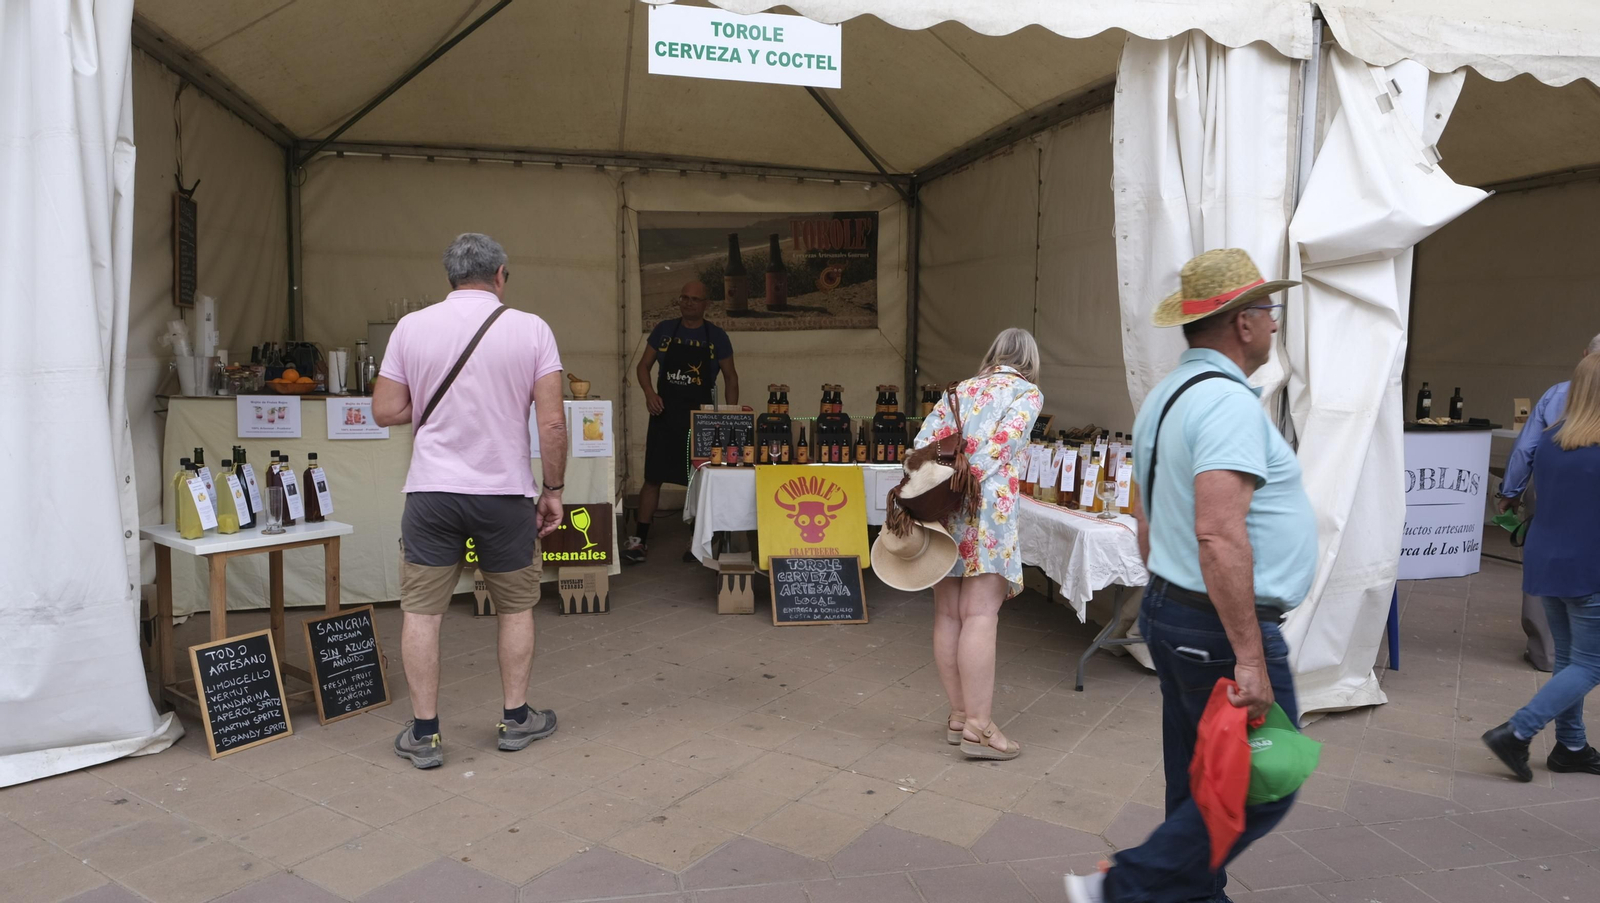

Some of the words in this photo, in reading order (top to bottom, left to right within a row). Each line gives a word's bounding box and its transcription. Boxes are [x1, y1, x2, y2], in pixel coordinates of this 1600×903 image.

[711, 21, 784, 43] TOROLE
[655, 41, 741, 64] CERVEZA
[748, 49, 761, 65] Y
[766, 51, 838, 71] COCTEL
[667, 369, 702, 386] sabores
[1435, 523, 1475, 535] artesanos
[541, 550, 607, 561] tesanales
[789, 547, 841, 556] CRAFTBEERS
[1400, 547, 1420, 556] rca
[1423, 542, 1438, 556] de
[1440, 542, 1459, 556] Los
[786, 558, 843, 572] TOROLE
[777, 571, 843, 586] CERVEZA
[780, 582, 851, 597] ARTESANA
[795, 596, 836, 607] LOCAL
[783, 606, 813, 614] ENTREGA
[316, 616, 371, 636] SANGRIA
[327, 630, 363, 644] ARTESANA
[205, 645, 248, 661] TODO
[320, 648, 340, 661] SIN
[345, 637, 376, 654] AZUCAR
[209, 653, 267, 677] ARTESANO
[323, 678, 348, 691] FRESH
[351, 670, 373, 683] FRUIT
[210, 686, 249, 702] VERMUT
[213, 690, 271, 713] MANDARINA
[338, 688, 373, 705] SANGRIA
[217, 707, 256, 723] APEROL
[256, 697, 282, 711] SPRITZ
[253, 709, 281, 725] SPRITZ
[222, 729, 261, 747] BRANDY
[264, 721, 287, 736] SPRITZ
